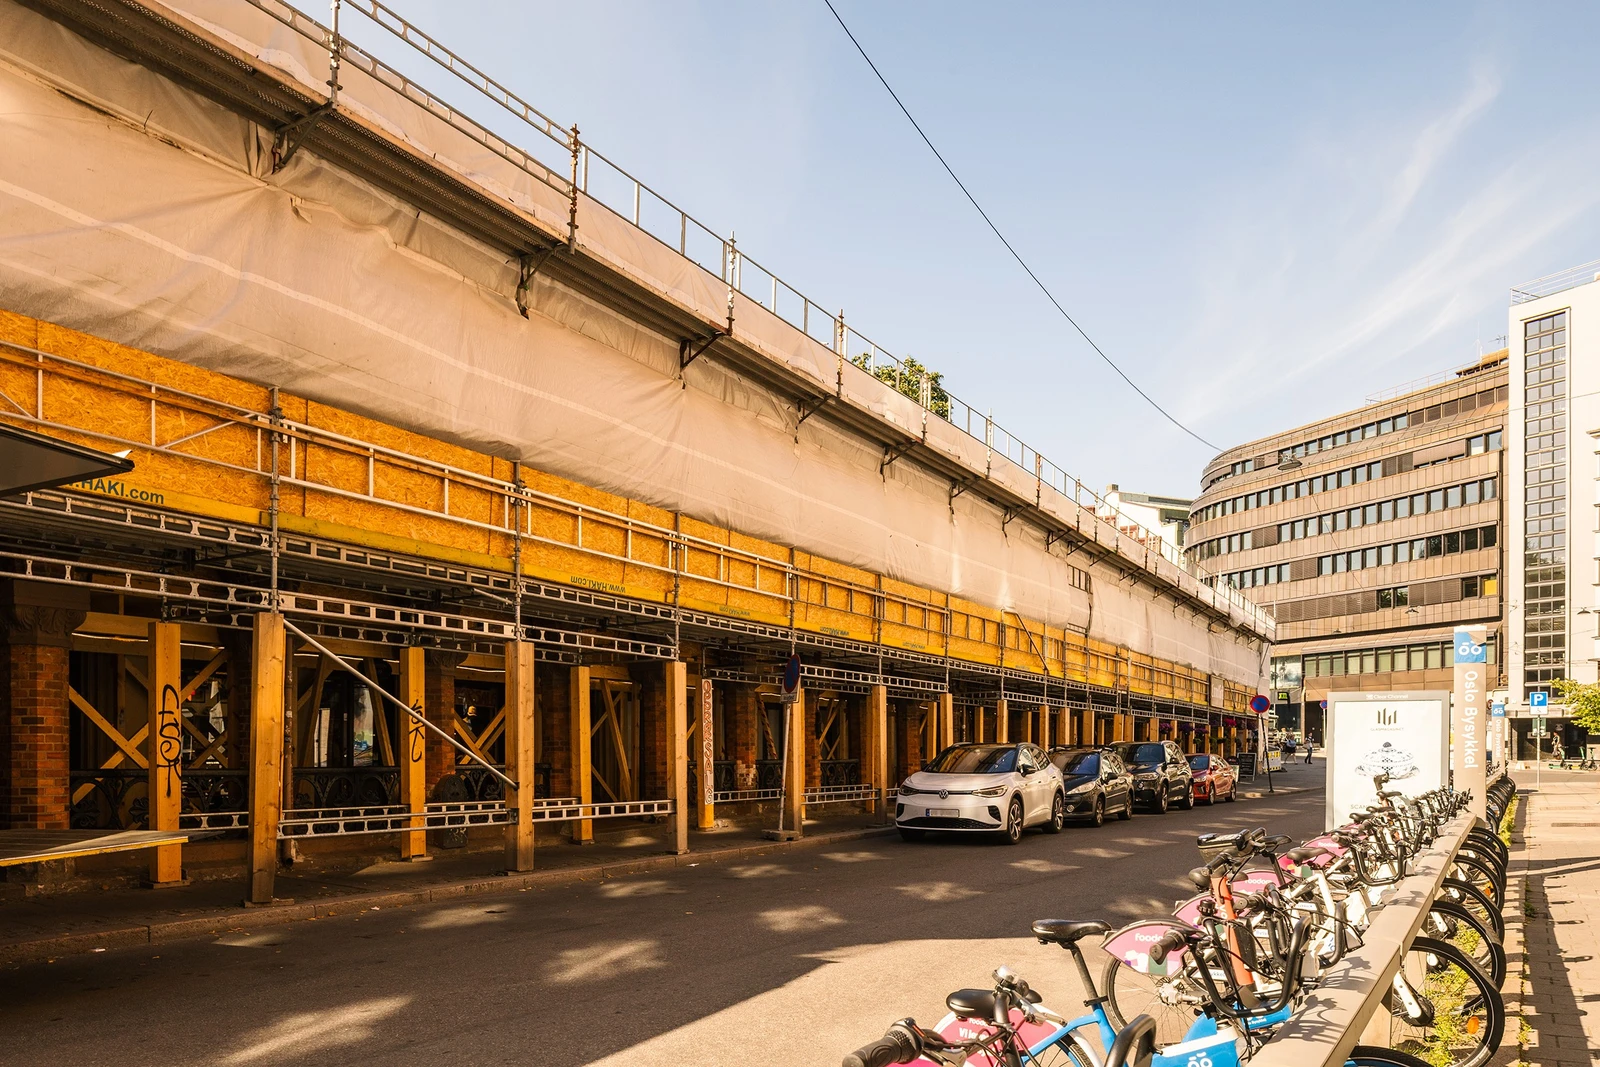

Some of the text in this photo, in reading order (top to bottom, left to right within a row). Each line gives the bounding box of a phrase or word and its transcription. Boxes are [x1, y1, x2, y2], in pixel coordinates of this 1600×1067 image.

[68, 479, 164, 504] .HAKI.com
[570, 576, 626, 594] www.HAKI.com
[1534, 694, 1544, 705] P
[1461, 670, 1479, 768] Oslo Bysykkel
